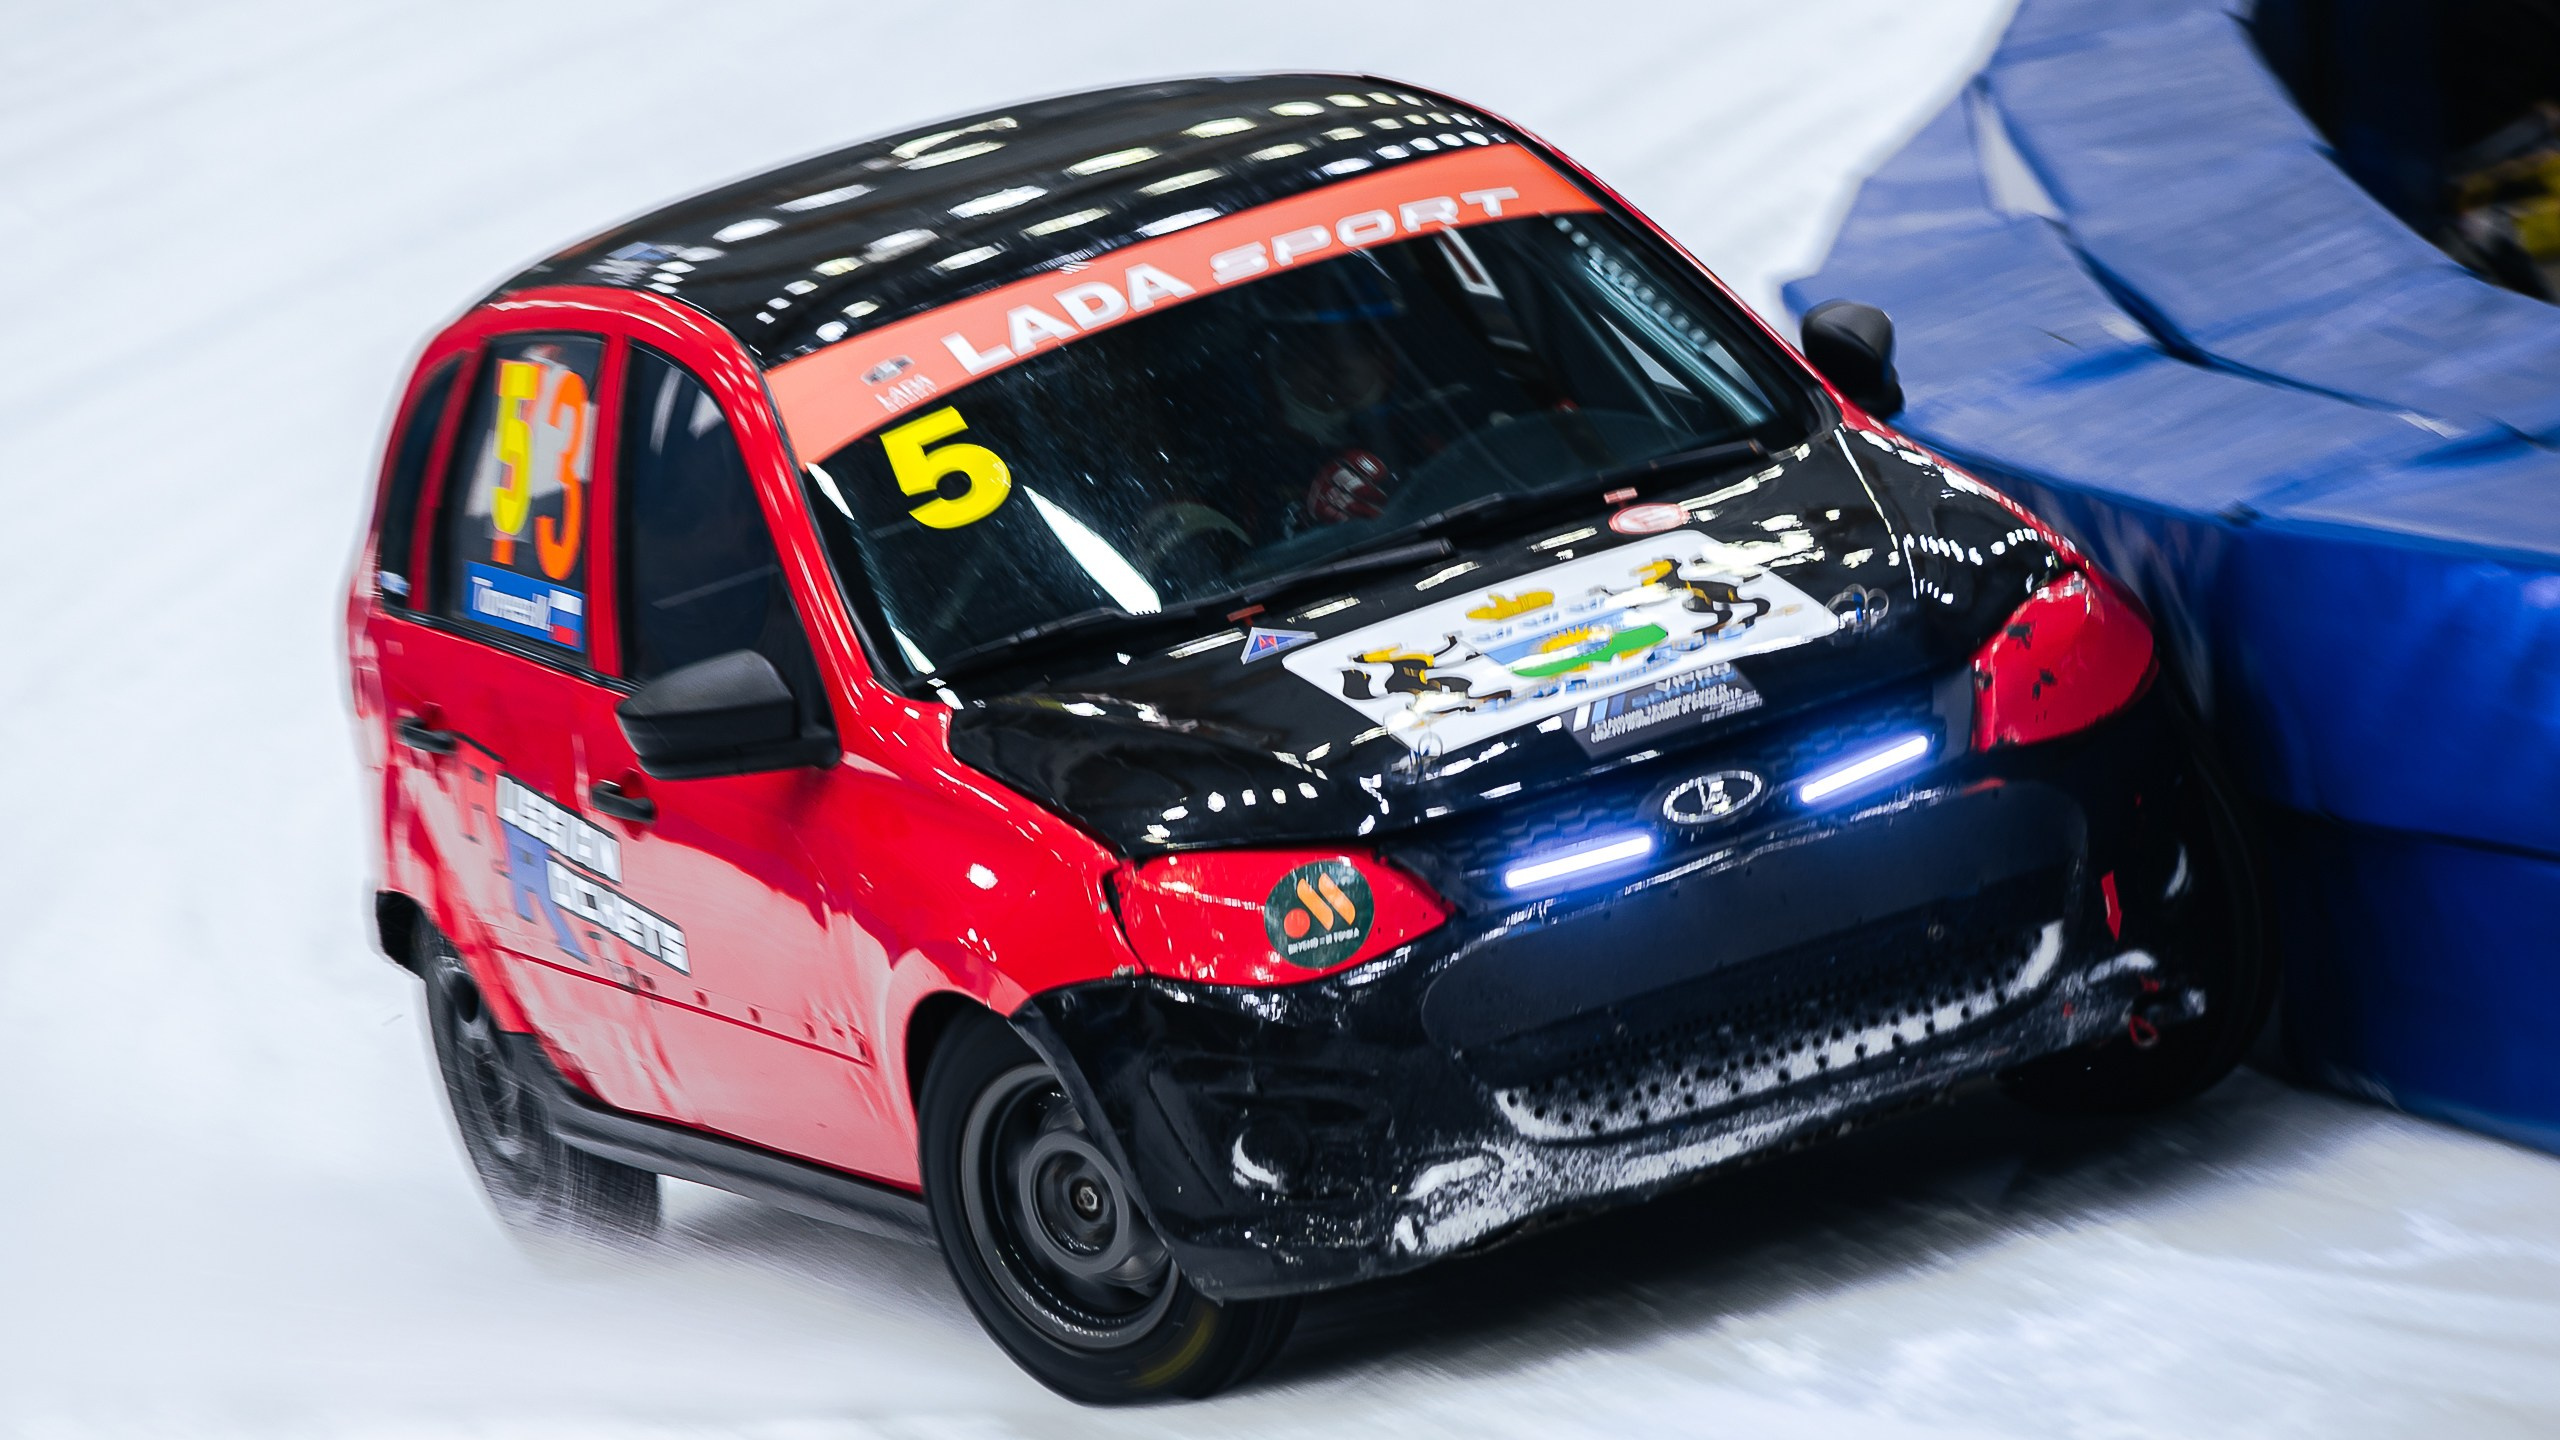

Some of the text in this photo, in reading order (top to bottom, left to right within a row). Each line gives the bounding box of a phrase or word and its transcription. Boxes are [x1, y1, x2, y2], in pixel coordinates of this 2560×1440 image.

[940, 186, 1521, 377] LADA SPORT
[879, 405, 1012, 529] 5
